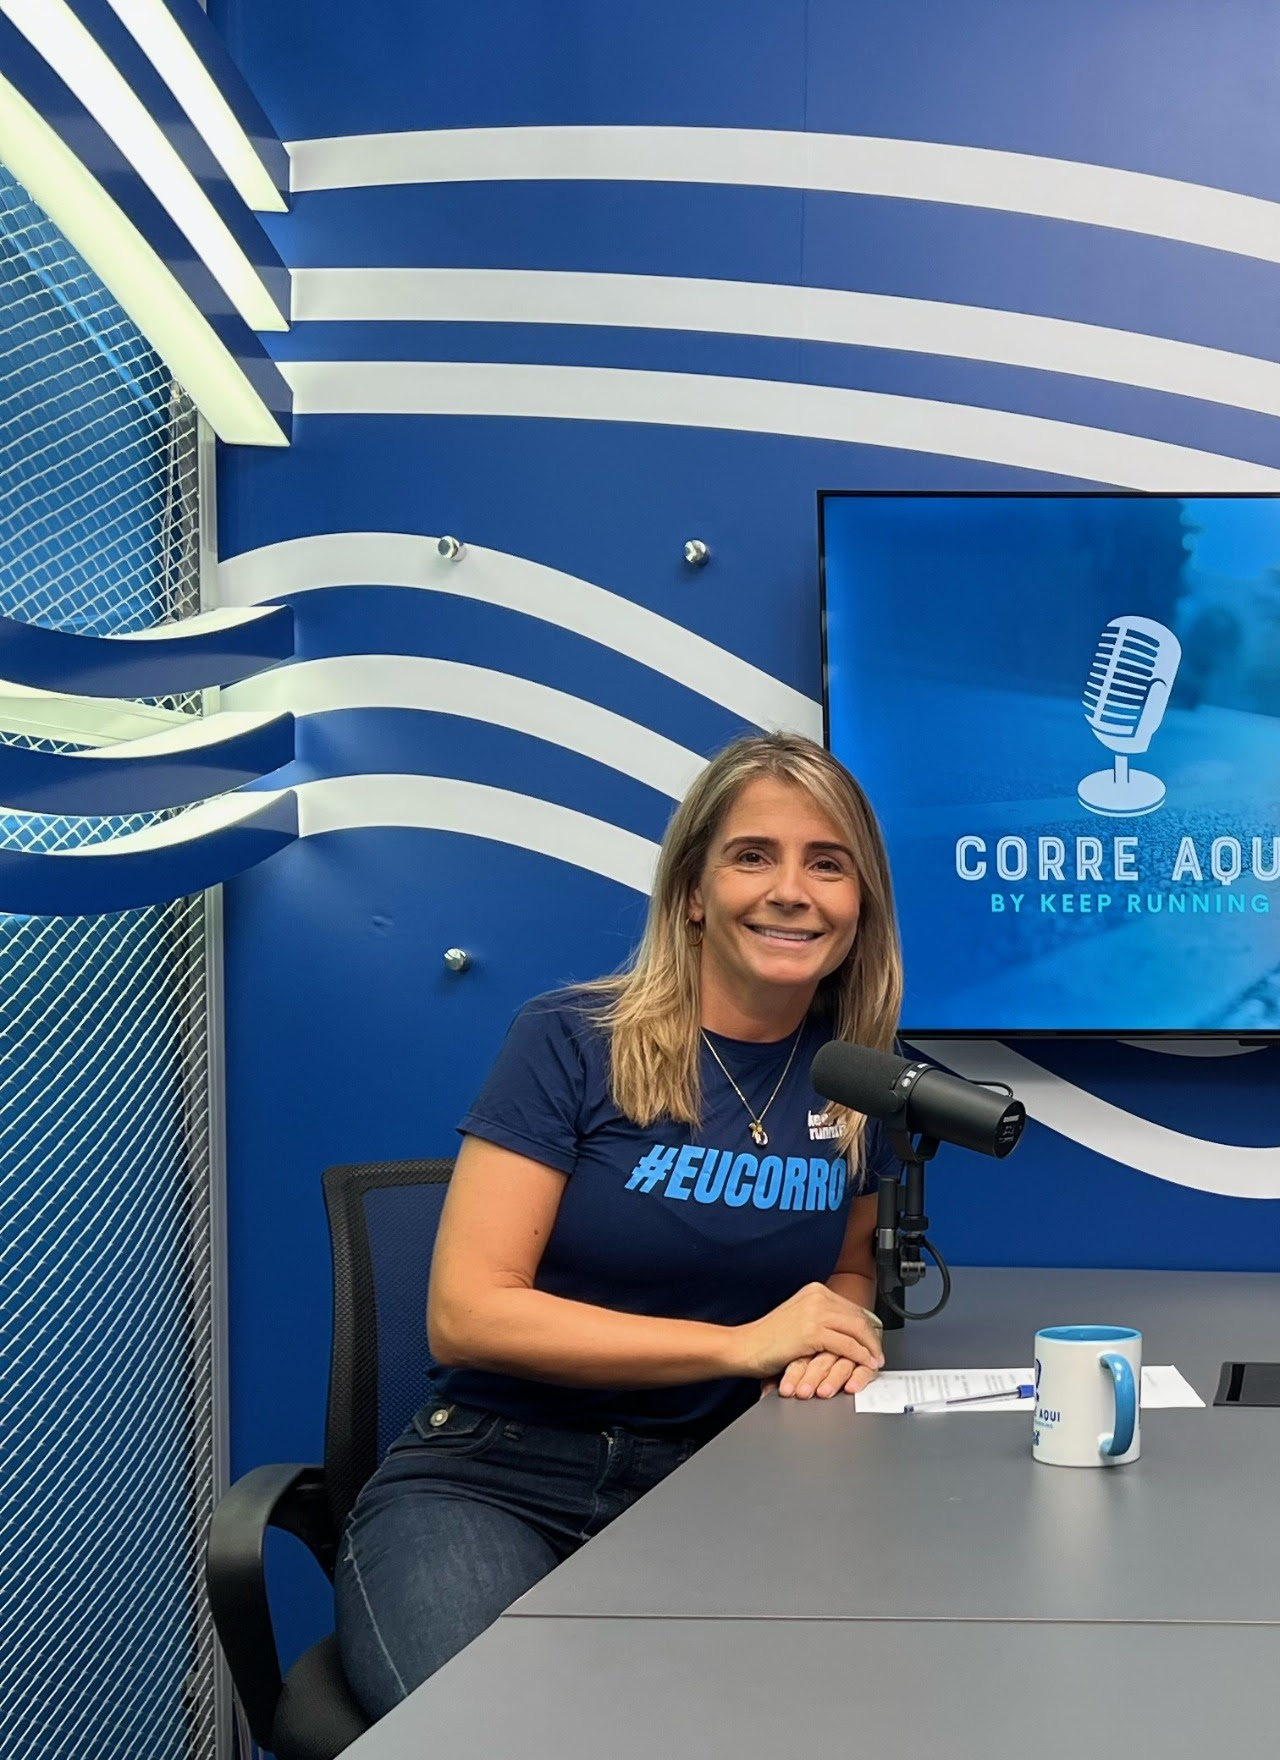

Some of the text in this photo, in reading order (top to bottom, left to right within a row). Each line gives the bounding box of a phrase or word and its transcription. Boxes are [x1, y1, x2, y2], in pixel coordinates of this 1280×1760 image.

[955, 835, 1139, 881] CORRE
[991, 894, 1270, 913] BY KEEP RUNNING
[624, 1144, 847, 1211] #EUCORRO
[1039, 1408, 1060, 1422] AQUI
